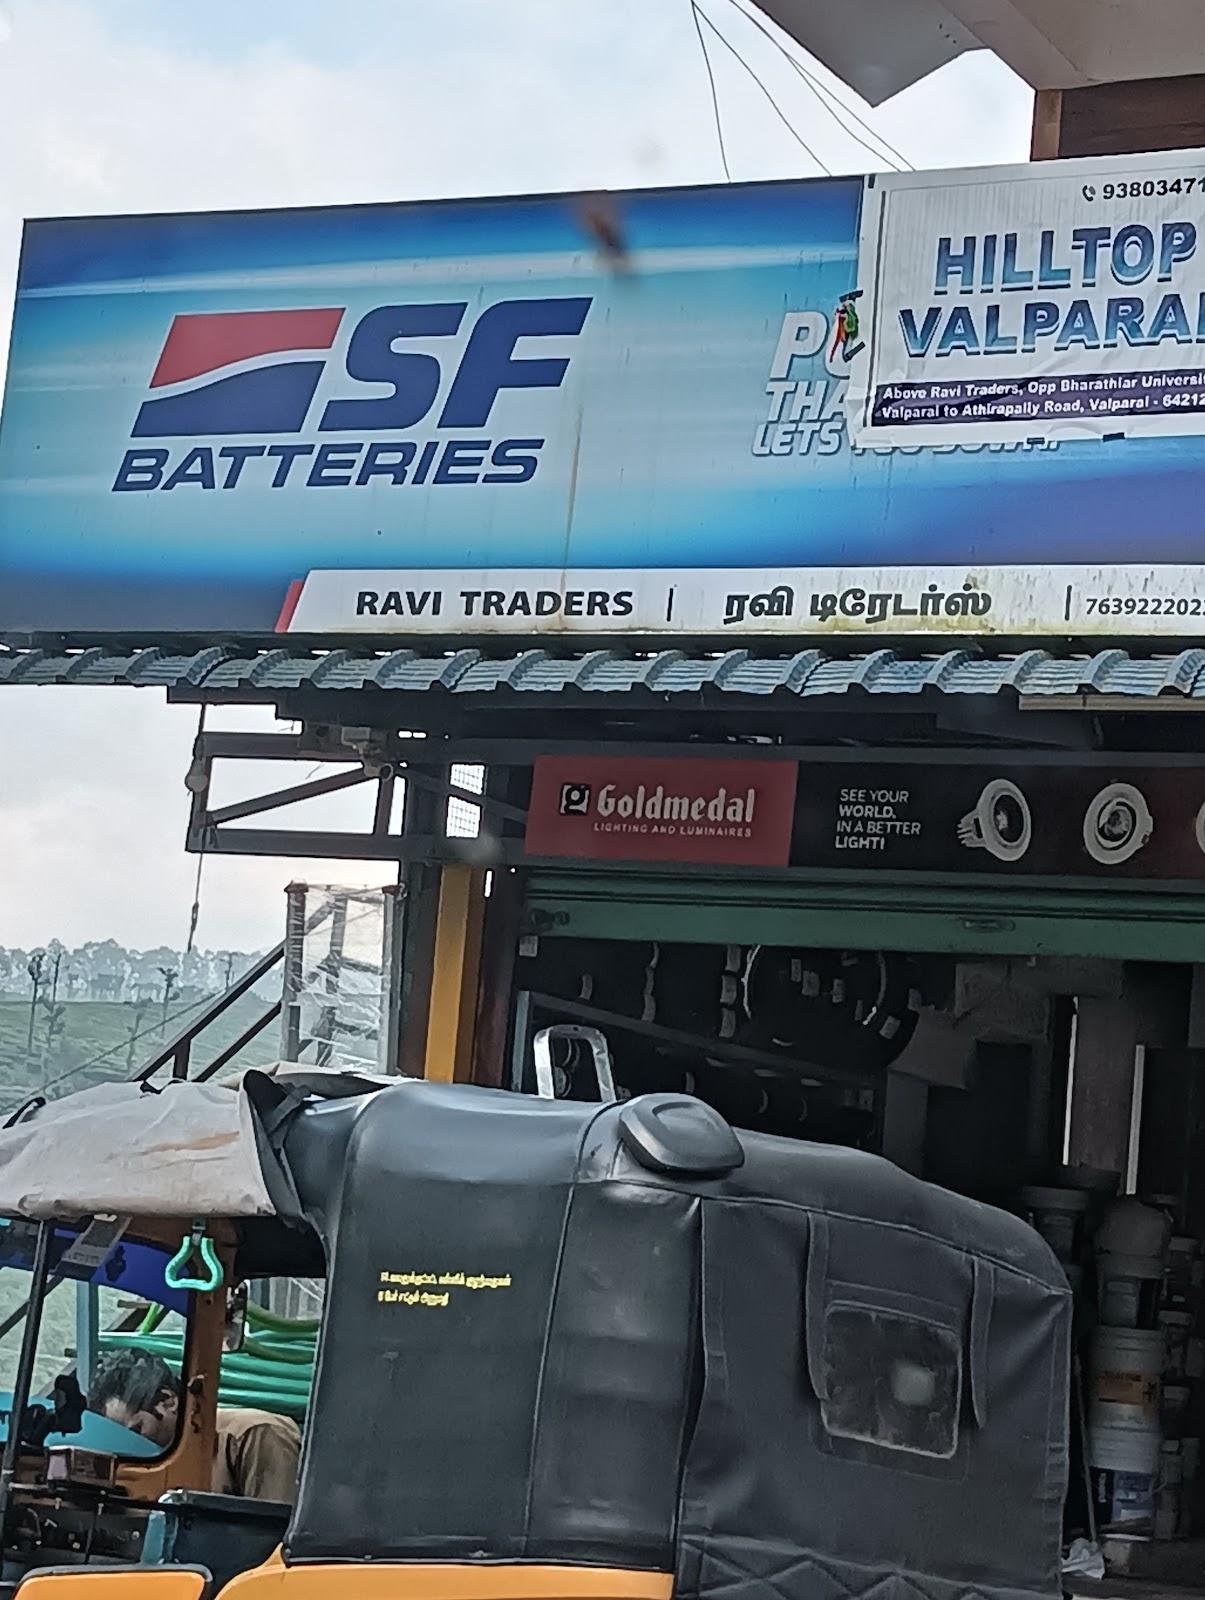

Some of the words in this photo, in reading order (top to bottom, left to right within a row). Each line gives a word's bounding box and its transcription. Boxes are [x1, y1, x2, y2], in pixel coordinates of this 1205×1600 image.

[933, 221, 1197, 296] HILLTOP
[317, 297, 593, 432] SF
[882, 386, 927, 399] Above
[930, 385, 961, 398] Ravi
[965, 382, 1023, 397] Traders,
[1027, 381, 1056, 395] Opp
[1060, 376, 1138, 392] Bharathiar
[882, 407, 939, 421] Valparai
[944, 405, 959, 417] to
[962, 402, 1040, 417] Athirapally
[1044, 401, 1084, 413] Road,
[1089, 396, 1149, 412] Valparai
[752, 421, 844, 457] LETS
[112, 439, 544, 492] BATTERIES
[356, 591, 442, 616] RAVI
[460, 591, 634, 616] TRADERS
[723, 585, 794, 624] ரவி
[810, 584, 992, 624] டிரேடர்ஸ்
[597, 784, 755, 823] Goldmedal
[840, 788, 867, 802] SEE
[870, 789, 909, 803] YOUR
[593, 822, 648, 834] LIGHTING
[652, 823, 676, 835] AND
[679, 825, 752, 838] LUMINAIRES
[837, 820, 852, 832] IN
[853, 820, 864, 832] A
[866, 821, 921, 835] BETTER
